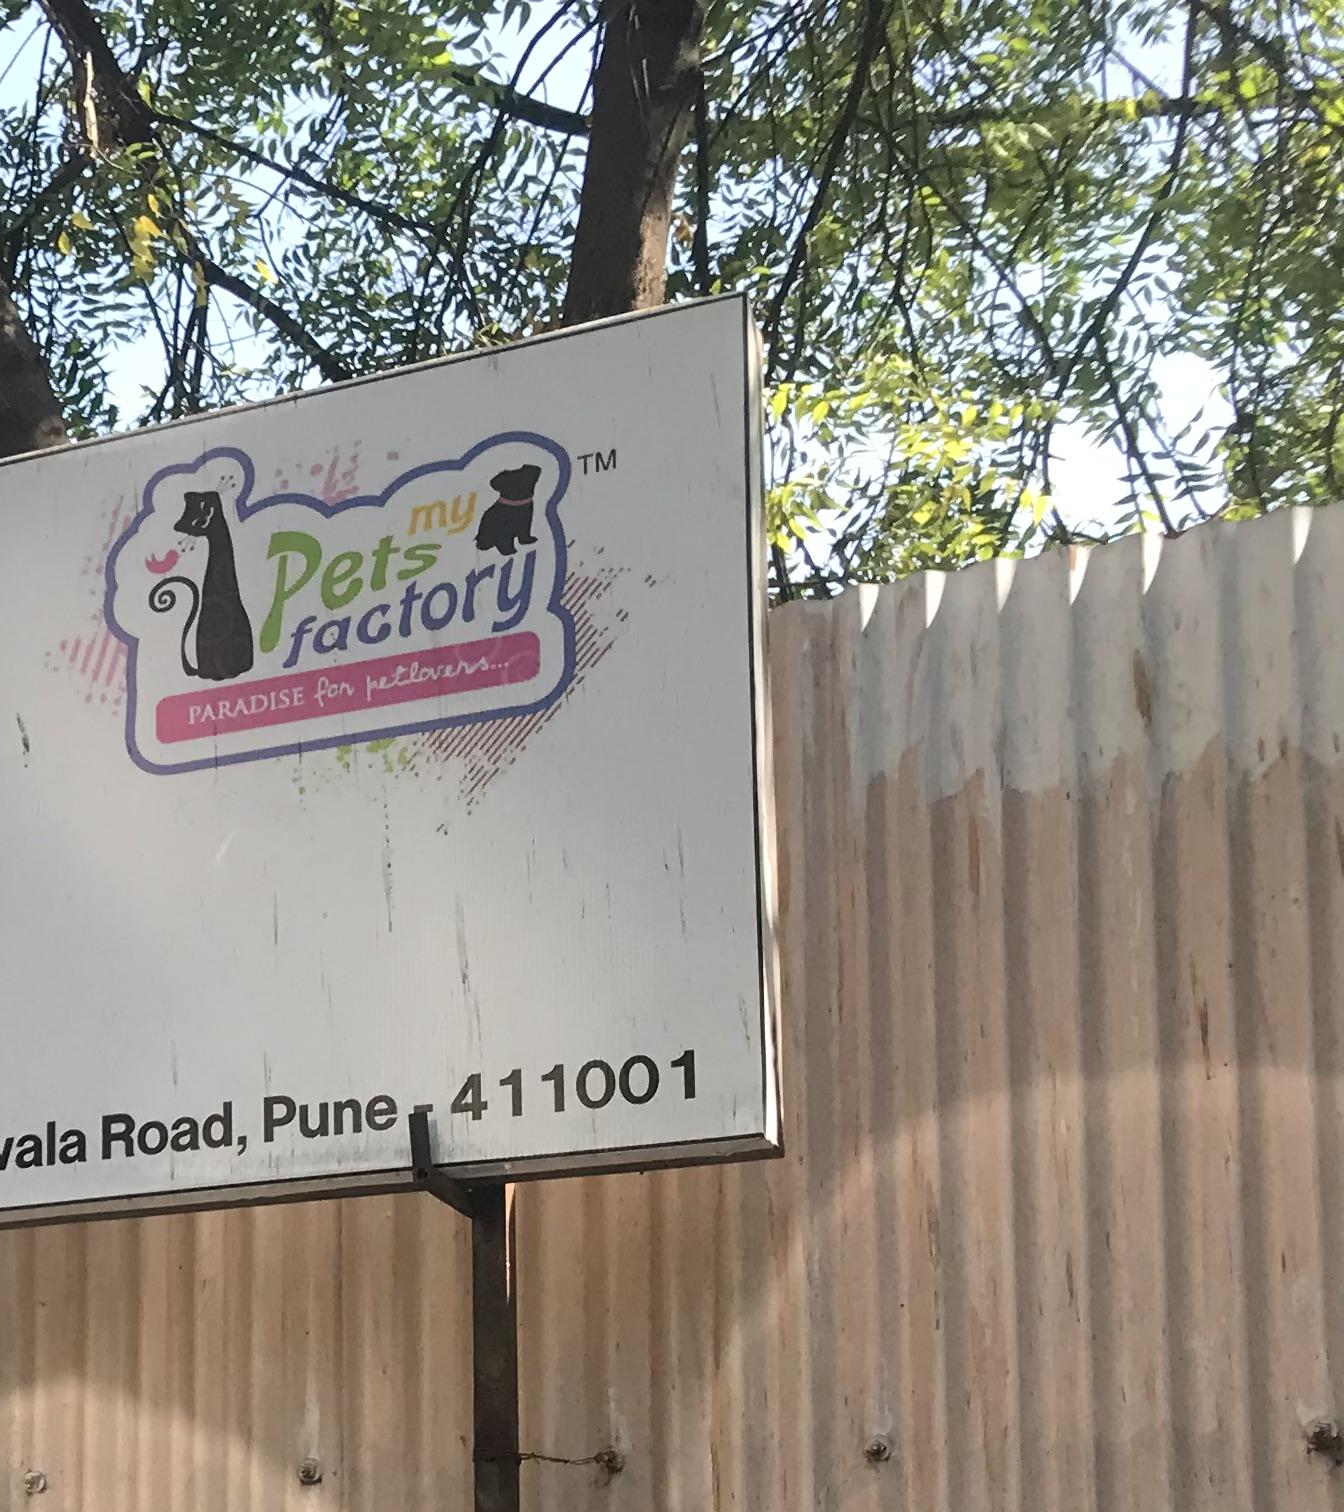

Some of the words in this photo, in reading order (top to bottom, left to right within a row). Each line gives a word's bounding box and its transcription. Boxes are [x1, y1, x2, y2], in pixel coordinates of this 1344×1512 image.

[409, 489, 479, 538] my
[260, 530, 440, 652] Pets
[282, 550, 536, 668] factory
[188, 687, 305, 725] PARADISE
[314, 676, 355, 707] for
[101, 1100, 247, 1160] Road,
[262, 1092, 398, 1143] Pune
[450, 1049, 699, 1121] 411001
